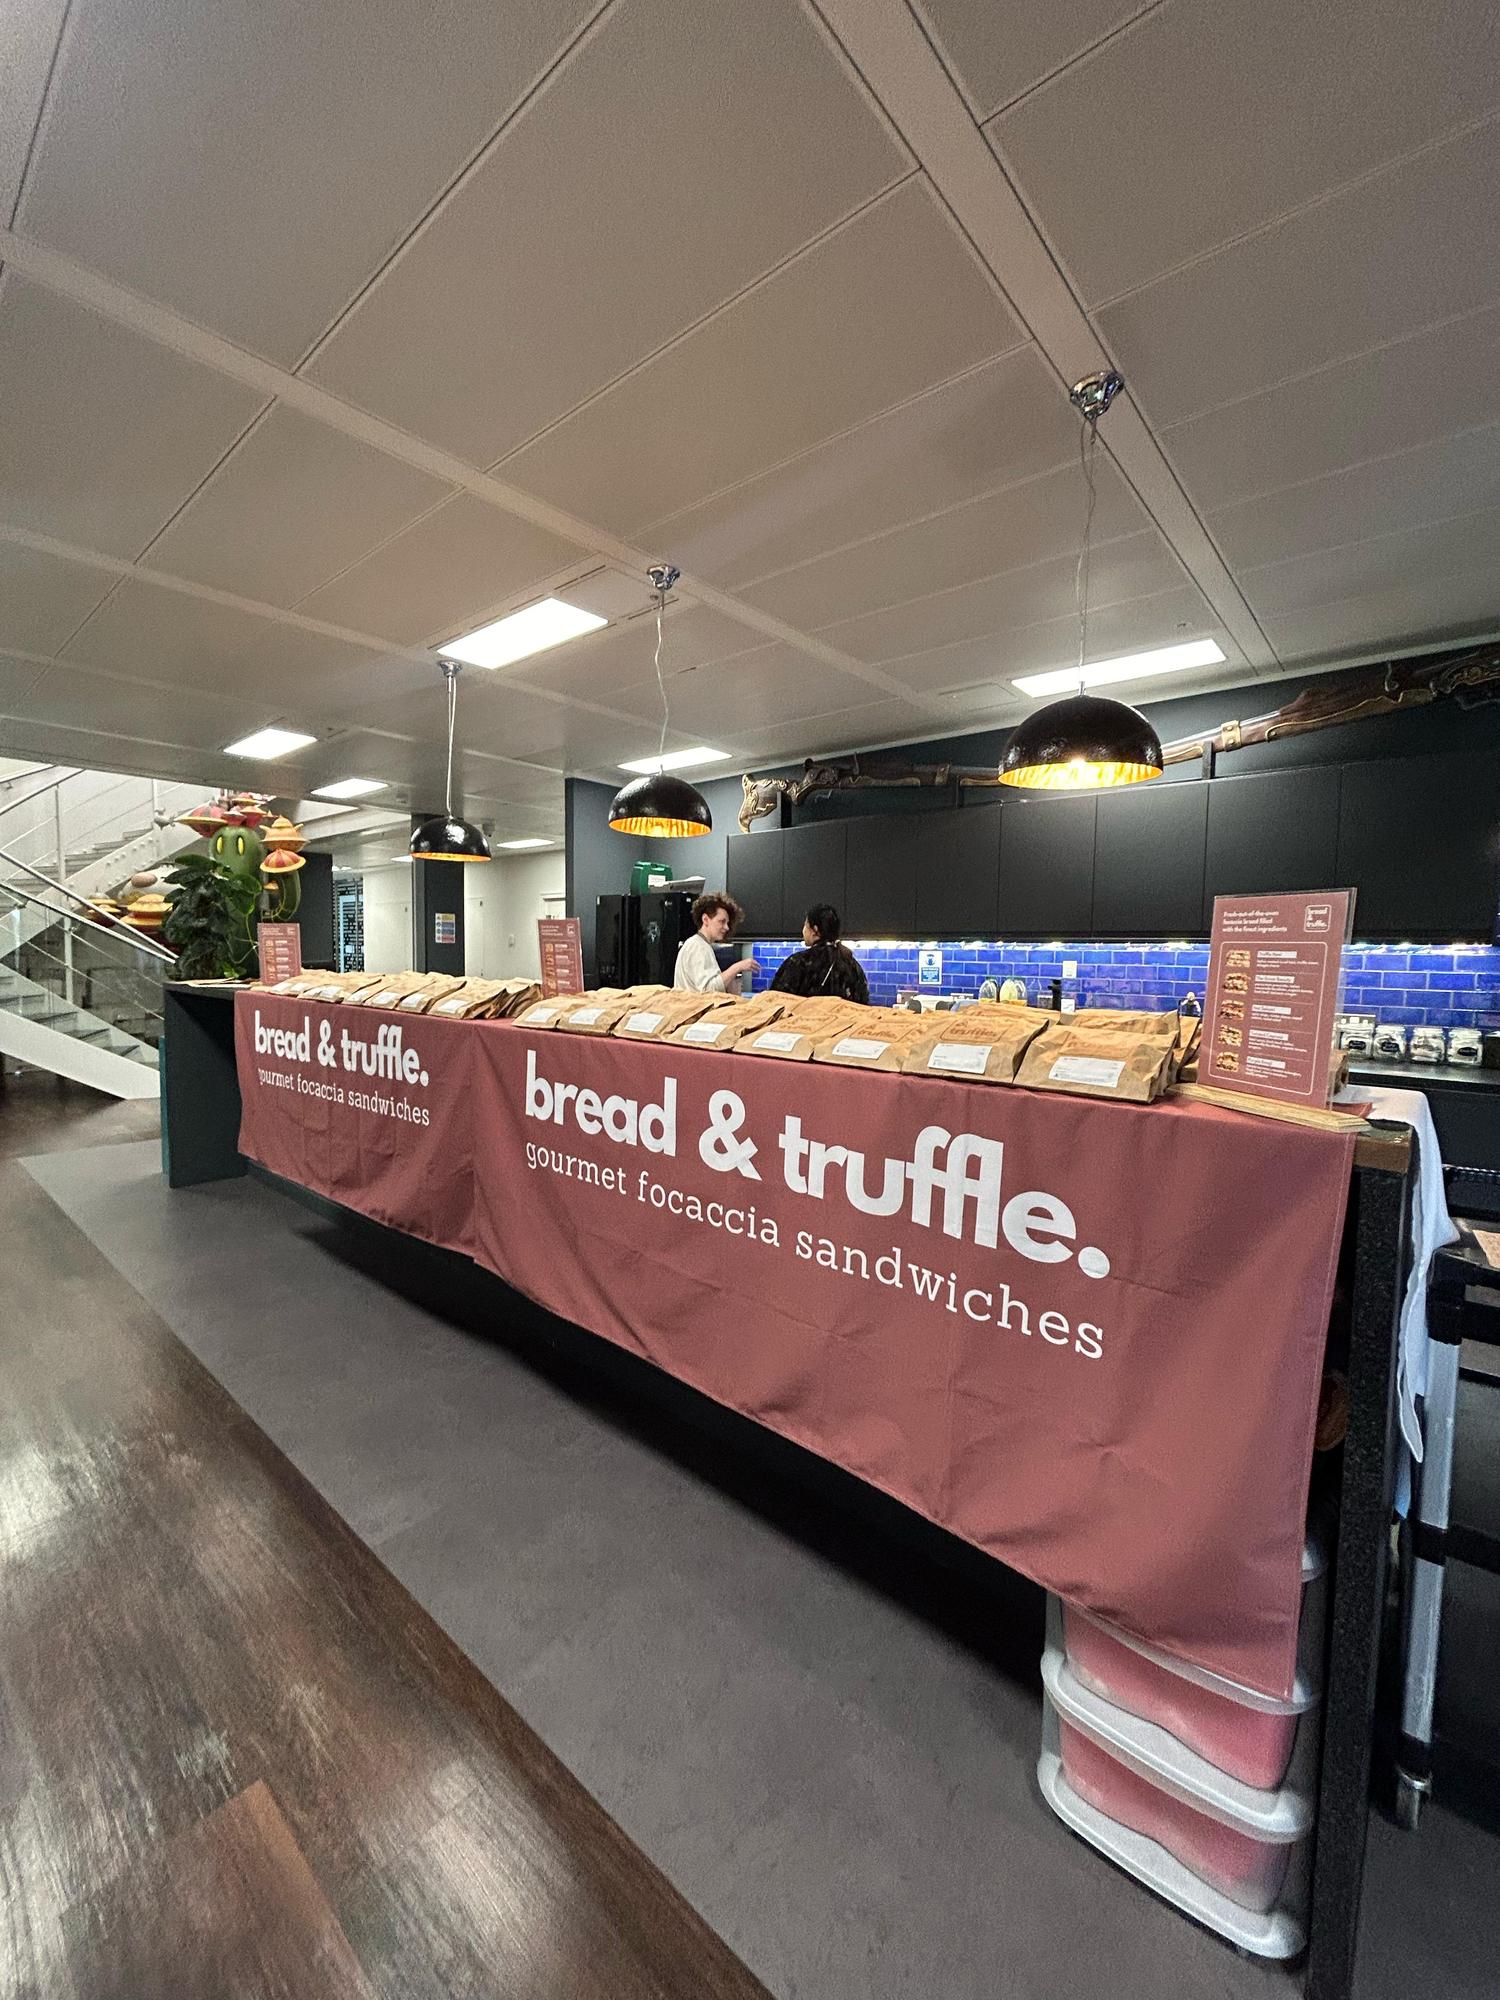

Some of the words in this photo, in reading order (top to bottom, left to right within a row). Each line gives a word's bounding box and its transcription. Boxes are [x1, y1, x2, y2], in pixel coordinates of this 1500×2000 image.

[1258, 925, 1288, 933] ingredients
[255, 1010, 310, 1063] bread
[317, 1019, 337, 1068] &
[341, 1023, 430, 1087] truffle.
[297, 1072, 345, 1104] focaccia
[347, 1089, 430, 1127] sandwiches
[525, 1050, 678, 1157] bread
[698, 1089, 763, 1182] &
[778, 1114, 1111, 1280] truffle.
[526, 1142, 627, 1195] gourmet
[638, 1170, 780, 1248] focaccia
[795, 1230, 1104, 1360] sandwiches
